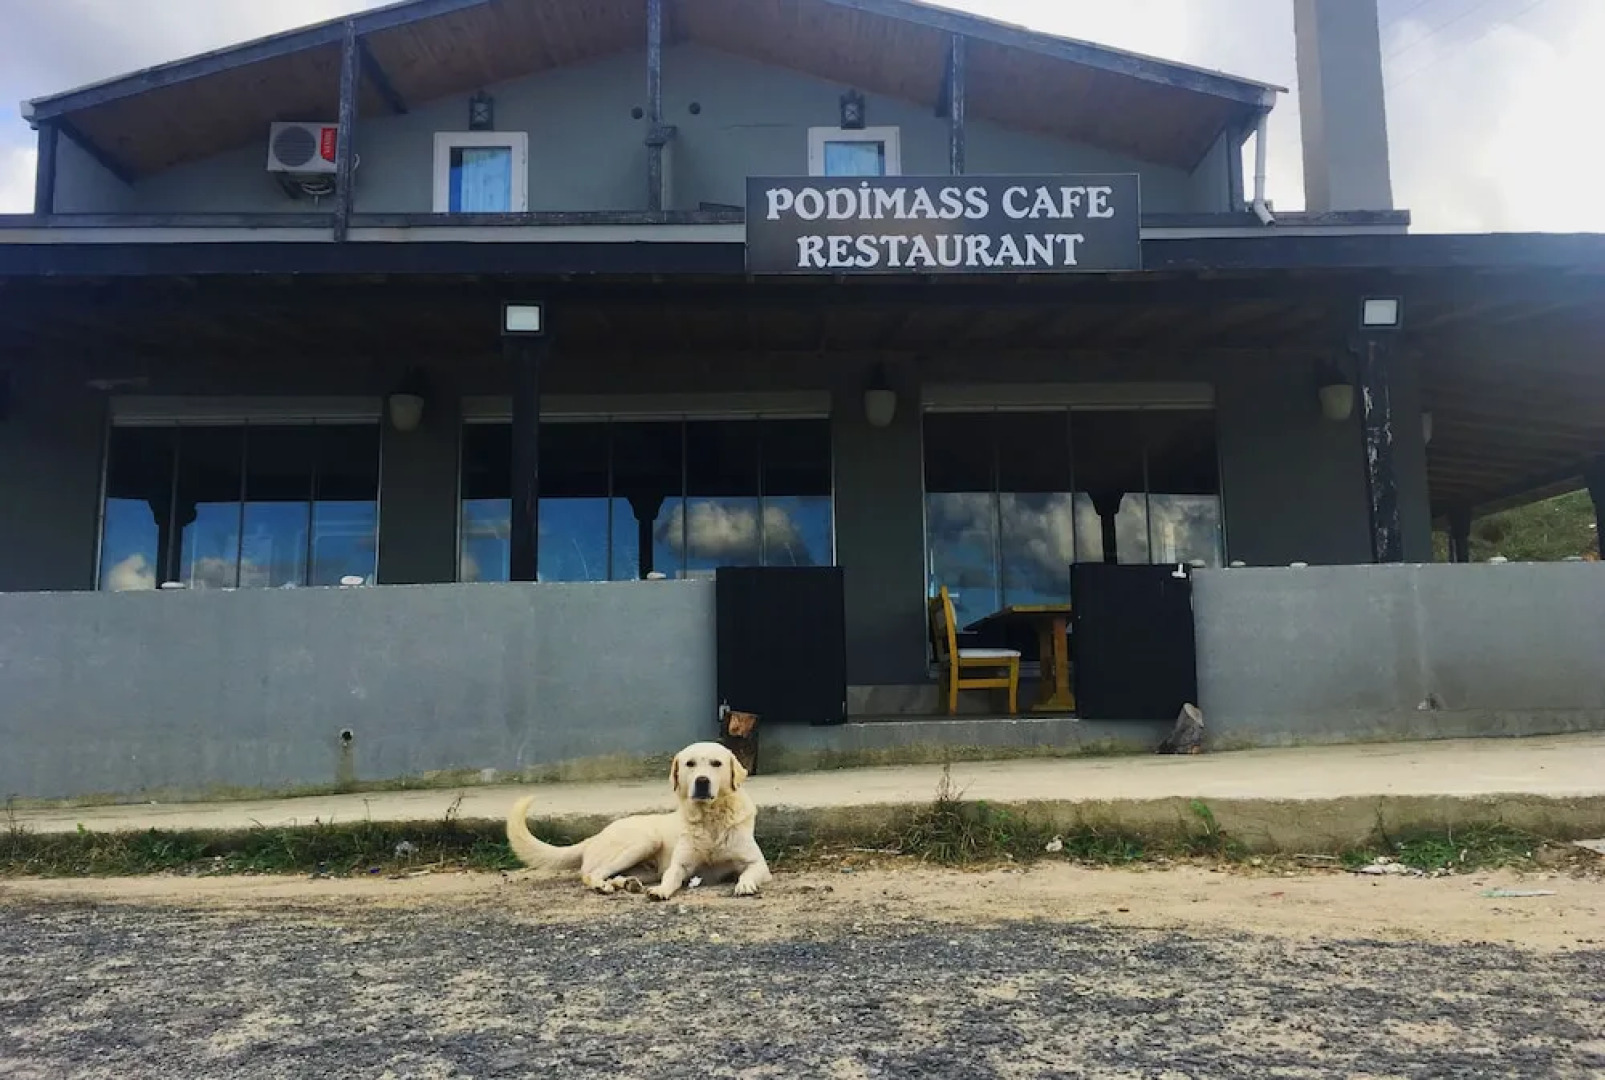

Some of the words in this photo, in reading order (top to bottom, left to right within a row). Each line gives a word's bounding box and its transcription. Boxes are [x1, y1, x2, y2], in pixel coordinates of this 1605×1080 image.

[766, 181, 989, 220] PODİMASS
[1002, 185, 1115, 218] CAFE
[797, 233, 1084, 268] RESTAURANT
